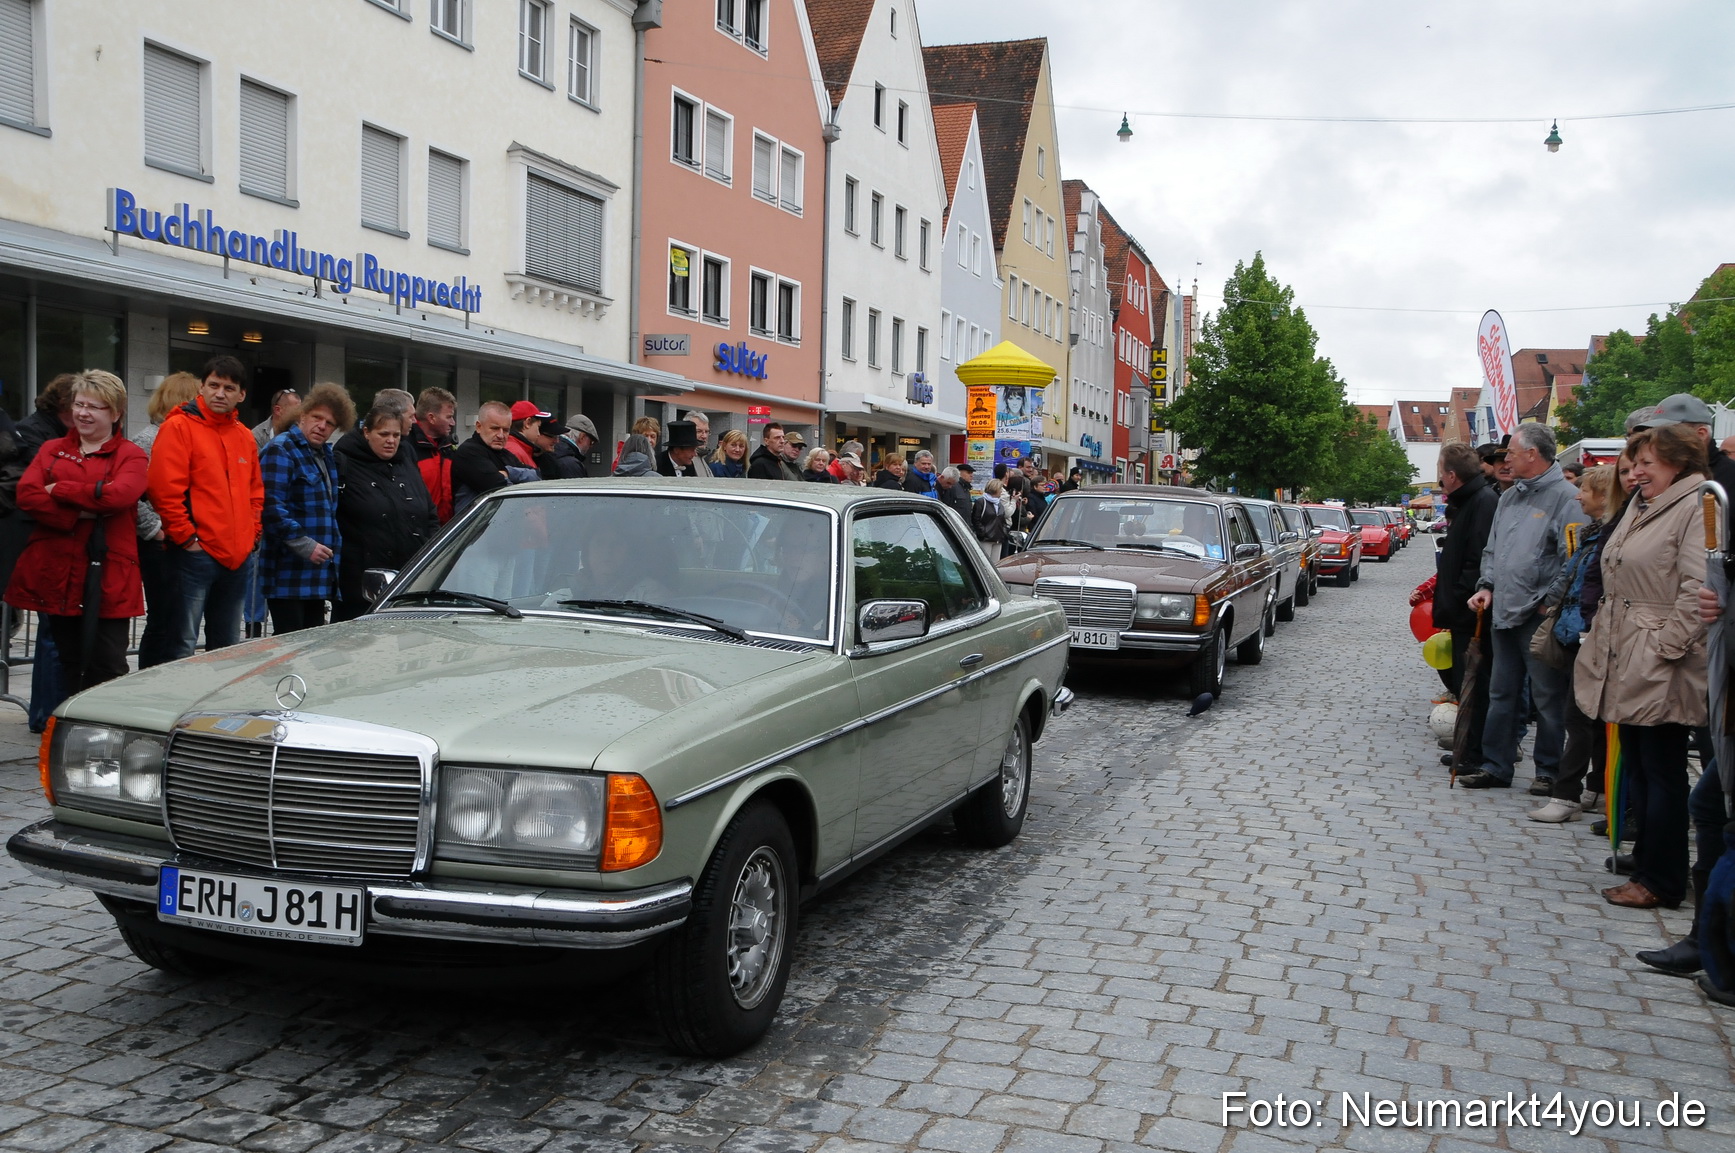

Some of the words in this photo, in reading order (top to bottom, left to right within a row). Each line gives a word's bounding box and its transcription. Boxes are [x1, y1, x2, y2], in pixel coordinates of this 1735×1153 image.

[114, 188, 353, 294] Buchhandlung
[363, 253, 482, 313] Rupprecht
[1151, 350, 1167, 432] HOTEL
[1083, 632, 1107, 645] 810
[165, 895, 173, 906] D
[178, 874, 237, 919] ERH
[196, 920, 314, 941] WWW.OFENWERK.DE
